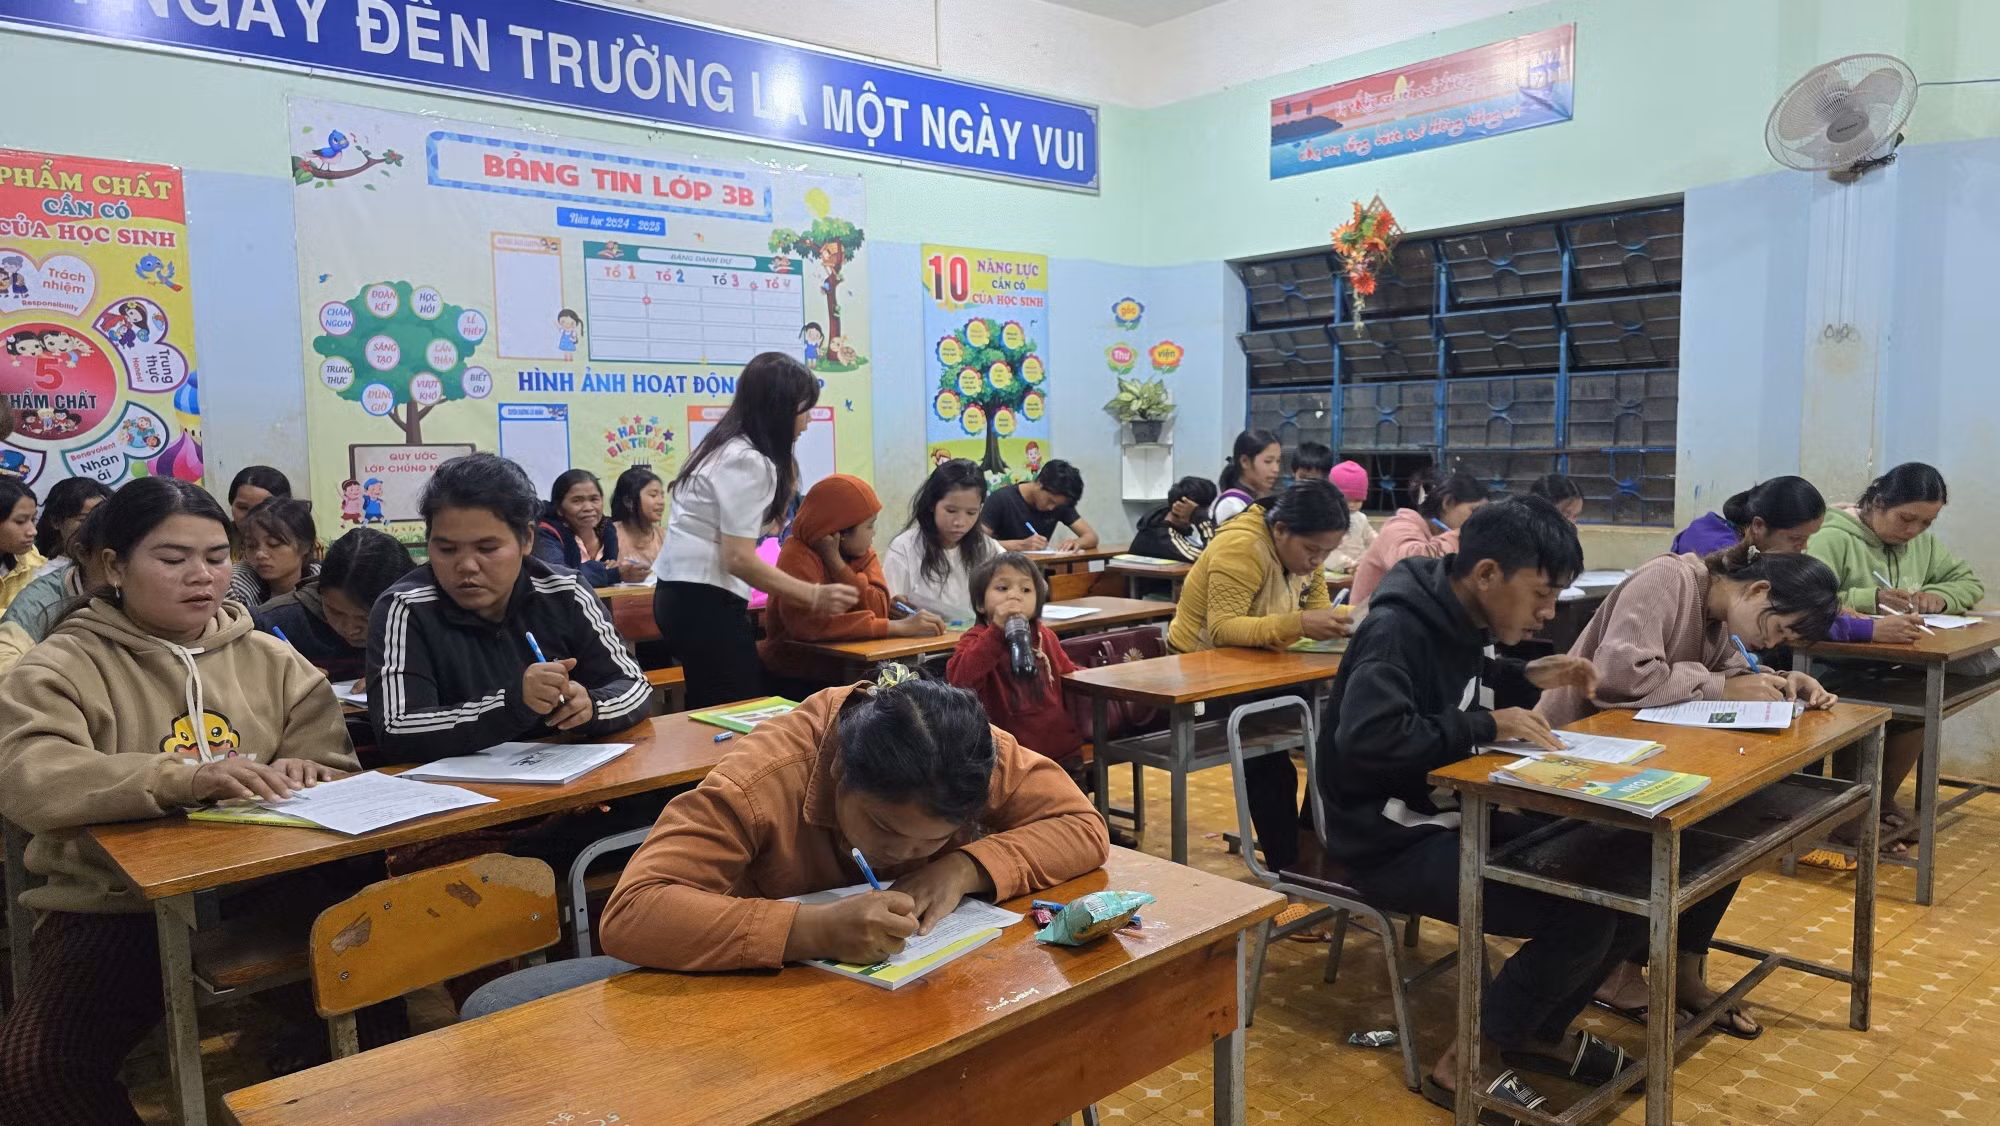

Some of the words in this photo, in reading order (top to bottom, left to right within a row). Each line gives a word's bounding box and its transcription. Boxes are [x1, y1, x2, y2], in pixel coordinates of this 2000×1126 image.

[508, 24, 734, 113] TRƯỜNG
[823, 81, 908, 147] MỘT
[921, 103, 1022, 160] NGÀY
[1033, 123, 1085, 171] VUI
[0, 160, 84, 192] PHẨM
[92, 172, 172, 199] CHẤT
[484, 151, 580, 187] BẢNG
[591, 168, 642, 194] TIN
[654, 175, 712, 201] LỚP
[722, 185, 755, 207] 3B
[43, 194, 93, 217] CẦN
[100, 201, 130, 219] CÓ
[605, 215, 630, 229] 2024
[0, 214, 51, 239] CỦA
[57, 224, 110, 245] HỌC
[117, 228, 176, 248] SINH
[48, 267, 86, 283] Trách
[627, 265, 636, 280] 1
[676, 269, 685, 283] 2
[929, 255, 969, 302] 10
[1016, 263, 1039, 280] LỰC
[42, 279, 85, 295] nhiệm
[713, 273, 727, 286] Tổ
[732, 274, 739, 287] 3
[419, 293, 438, 302] HỌC
[1020, 297, 1044, 308] SINH
[22, 300, 79, 312] Responsibility
[373, 342, 397, 352] SÁNG
[159, 349, 173, 384] Trung
[376, 355, 393, 365] TẠO
[35, 358, 63, 390] 5
[132, 357, 144, 383] Honest
[145, 355, 159, 383] thực
[326, 365, 353, 374] TRUNG
[327, 376, 348, 385] THỰC
[518, 368, 574, 393] HÌNH
[581, 367, 627, 393] ẢNH
[632, 374, 687, 397] HOẠT
[692, 372, 740, 398] ĐỘN
[2, 388, 49, 409] HẨM
[55, 389, 97, 409] CHẤT
[618, 424, 663, 439] HAPPY
[70, 442, 116, 462] Benevolent
[607, 437, 675, 457] BIRTHDAY
[80, 453, 120, 474] Nhân
[365, 463, 385, 473] LỚP
[388, 463, 427, 473] CHÚNG
[97, 469, 112, 481] ái
